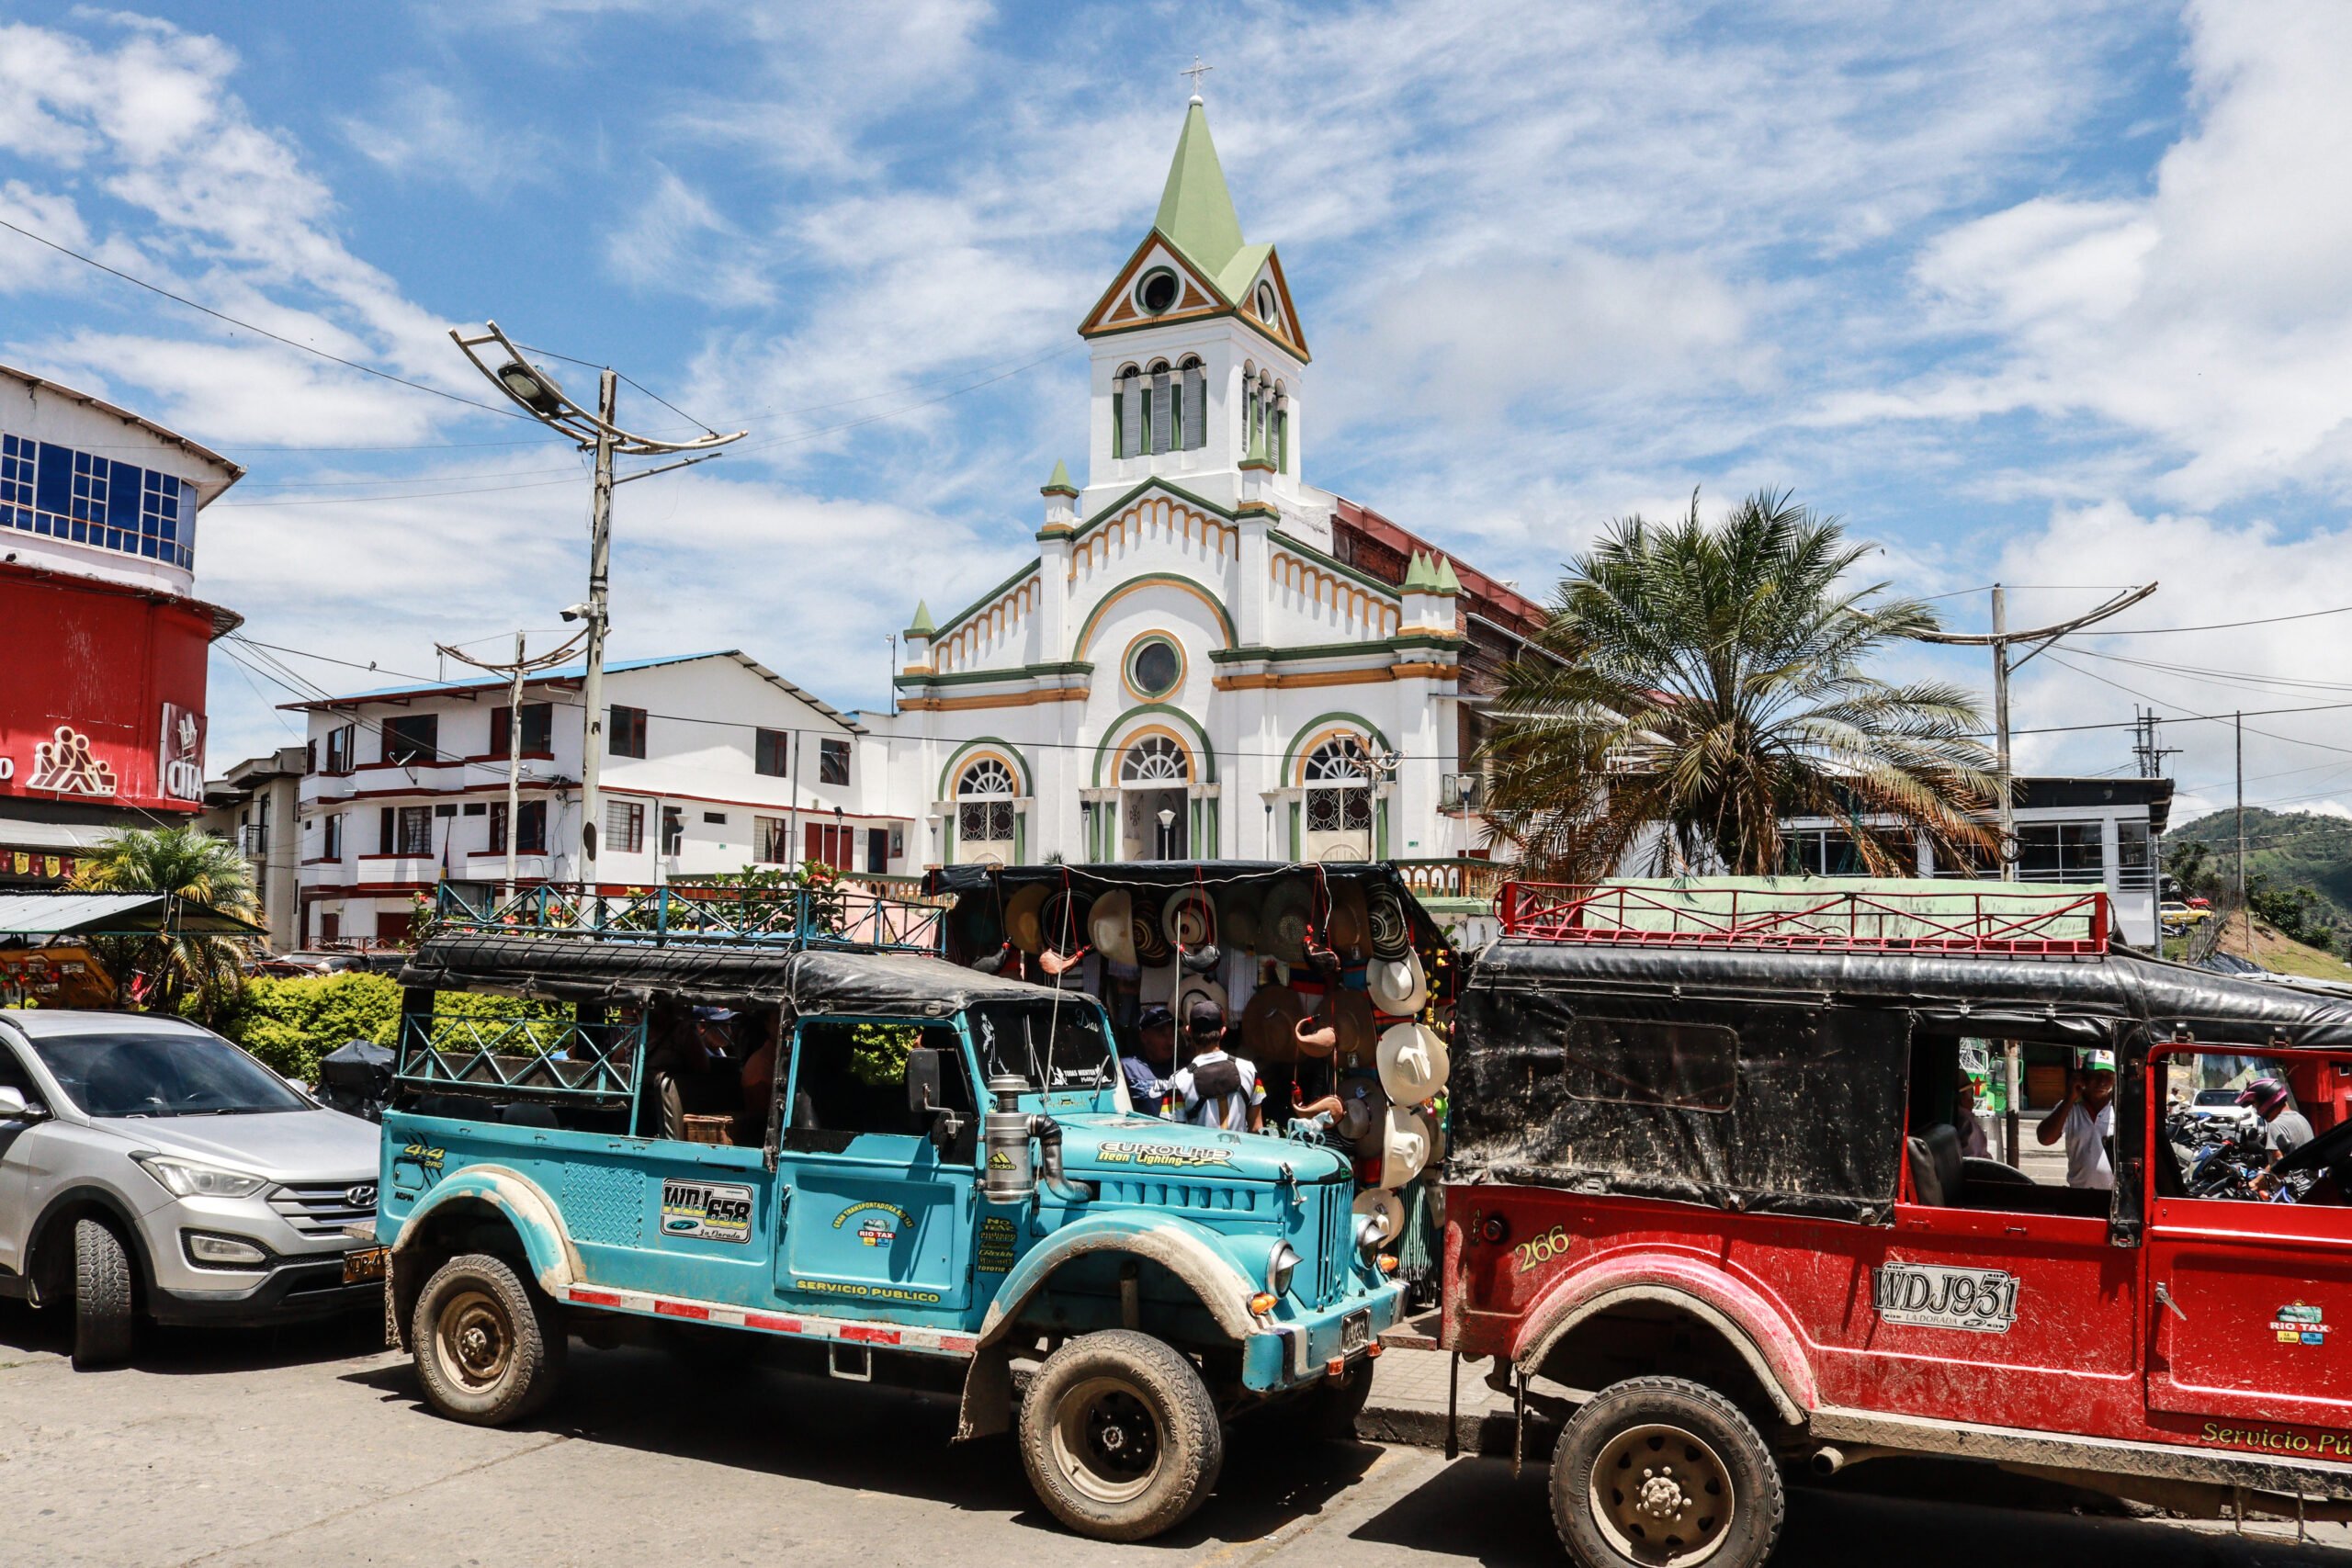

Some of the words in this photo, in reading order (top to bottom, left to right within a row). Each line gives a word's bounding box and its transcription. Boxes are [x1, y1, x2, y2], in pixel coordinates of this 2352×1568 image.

[167, 761, 204, 802] CITA
[404, 1144, 446, 1159] 4x4
[1098, 1141, 1235, 1160] EUROLITE
[1099, 1152, 1130, 1162] Neon
[1136, 1154, 1183, 1166] Lighting
[662, 1184, 714, 1218] WDJ
[704, 1198, 752, 1230] 658
[1514, 1224, 1569, 1273] 266
[796, 1280, 868, 1296] SERVICIO
[871, 1288, 940, 1303] PUBLICO
[1872, 1268, 2020, 1323] WDJ931
[1905, 1313, 1917, 1322] LA
[1919, 1314, 1958, 1325] DORADA
[2269, 1322, 2296, 1331] RIO
[2299, 1323, 2328, 1333] TAX
[2201, 1423, 2310, 1451] Servicio
[2317, 1434, 2352, 1455] Pú
